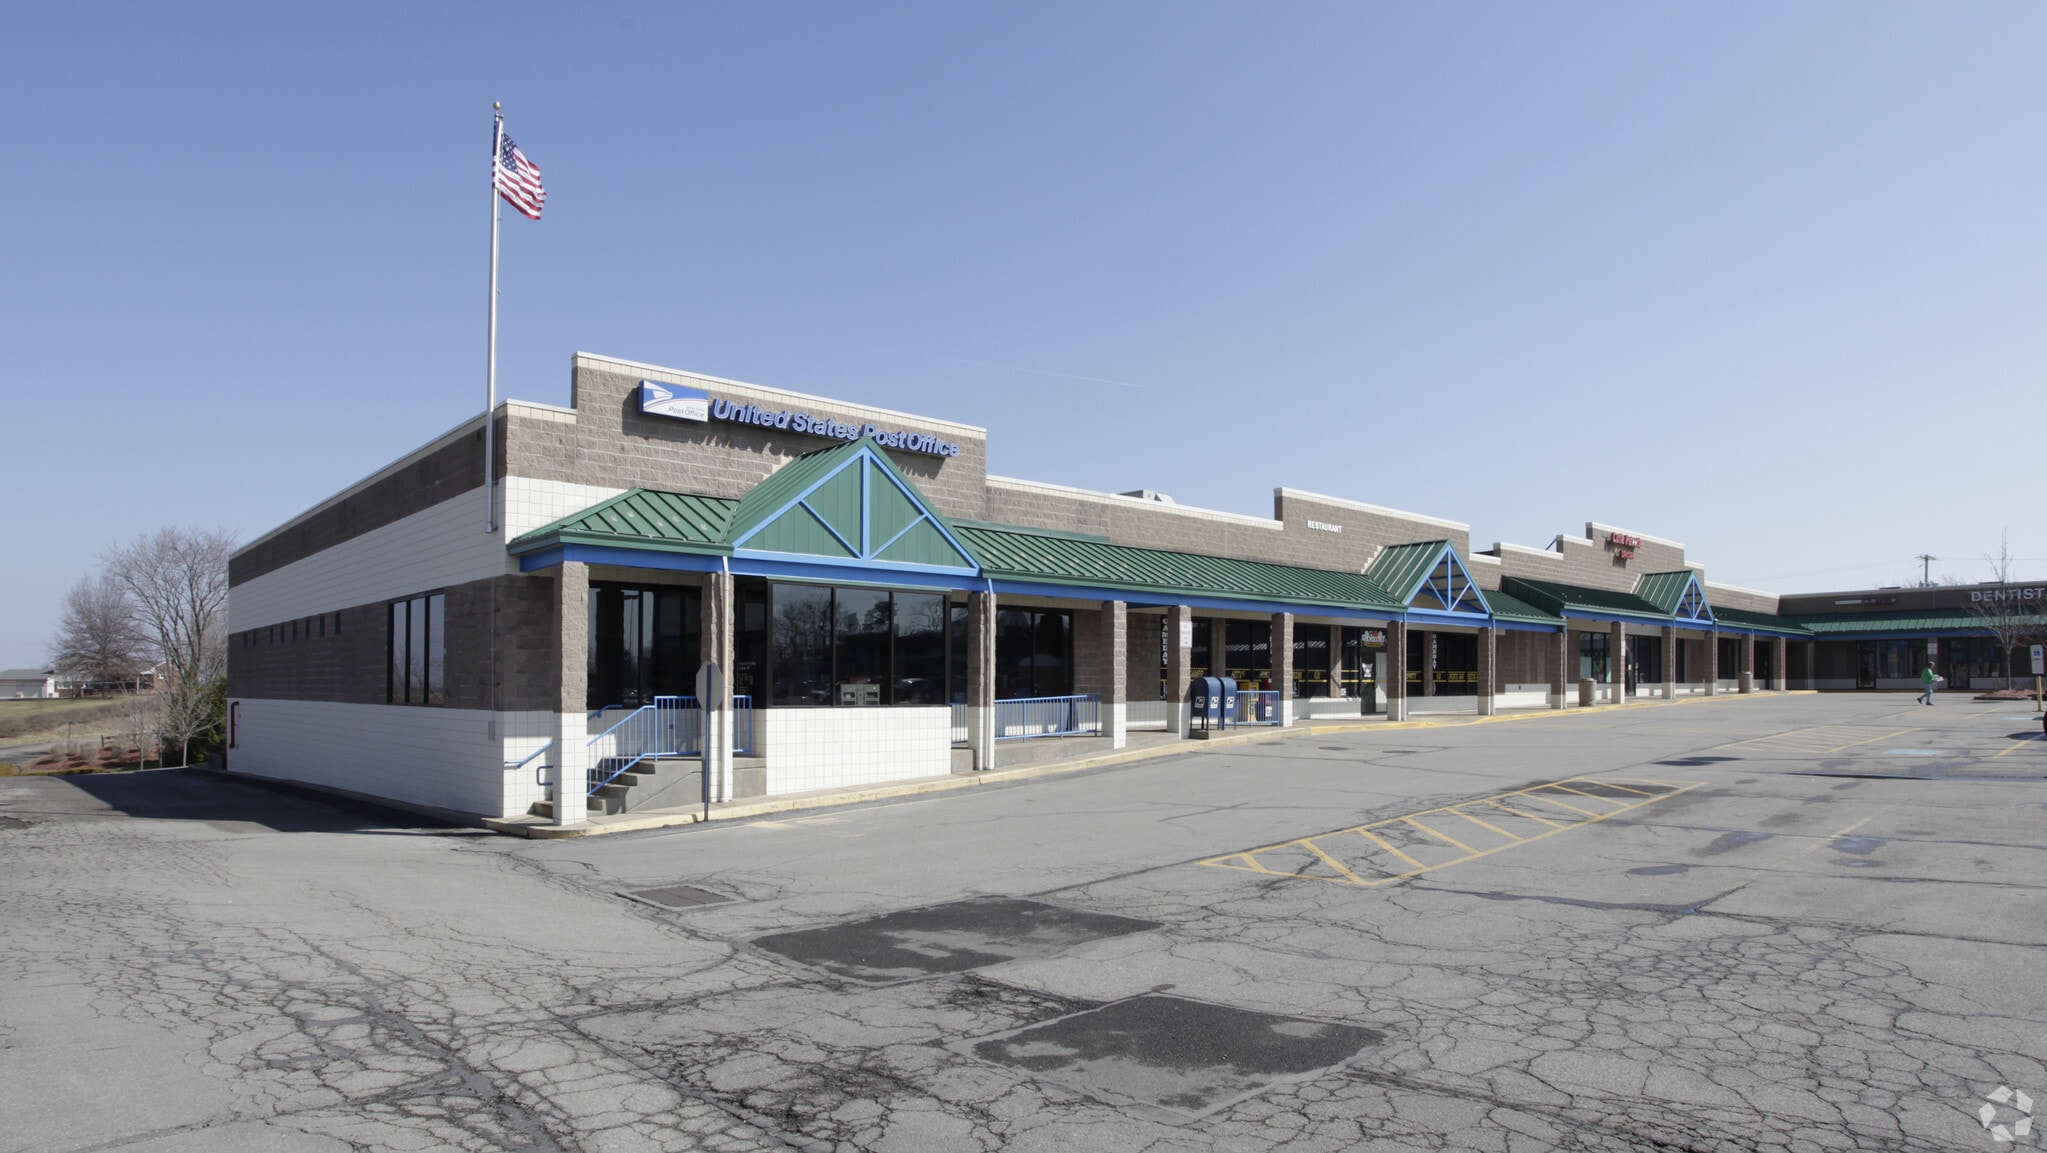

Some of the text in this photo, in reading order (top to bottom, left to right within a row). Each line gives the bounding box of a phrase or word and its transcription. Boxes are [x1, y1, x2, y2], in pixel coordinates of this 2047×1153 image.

[668, 406, 684, 415] Post
[684, 408, 705, 418] Office
[712, 398, 960, 457] United States Post Office
[1307, 520, 1342, 533] RESTAURANT
[1971, 587, 2045, 602] DENTIST
